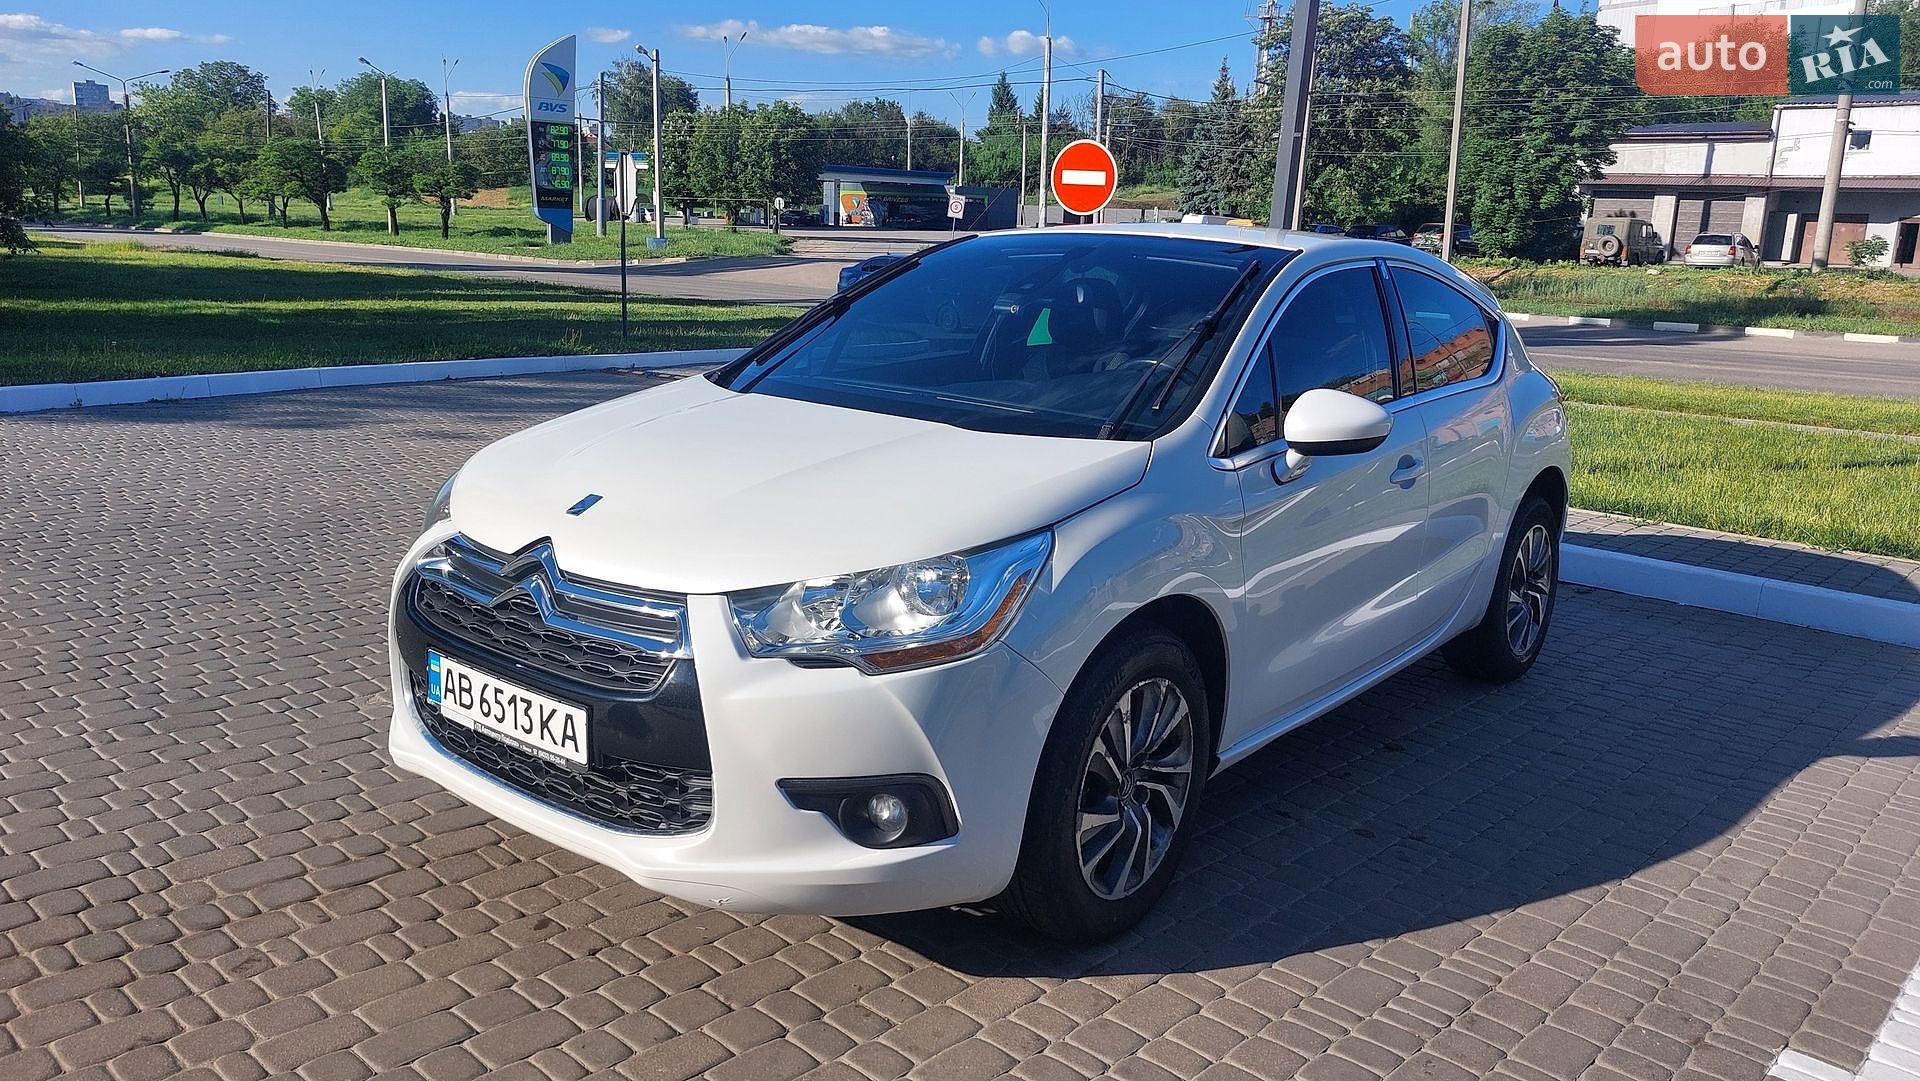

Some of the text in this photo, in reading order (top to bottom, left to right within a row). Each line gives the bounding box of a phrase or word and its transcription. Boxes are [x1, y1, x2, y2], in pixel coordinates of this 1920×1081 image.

[537, 101, 568, 113] BVS
[430, 683, 441, 696] UA
[444, 668, 474, 710] AB
[479, 683, 534, 735] 6513
[539, 703, 580, 754] KA
